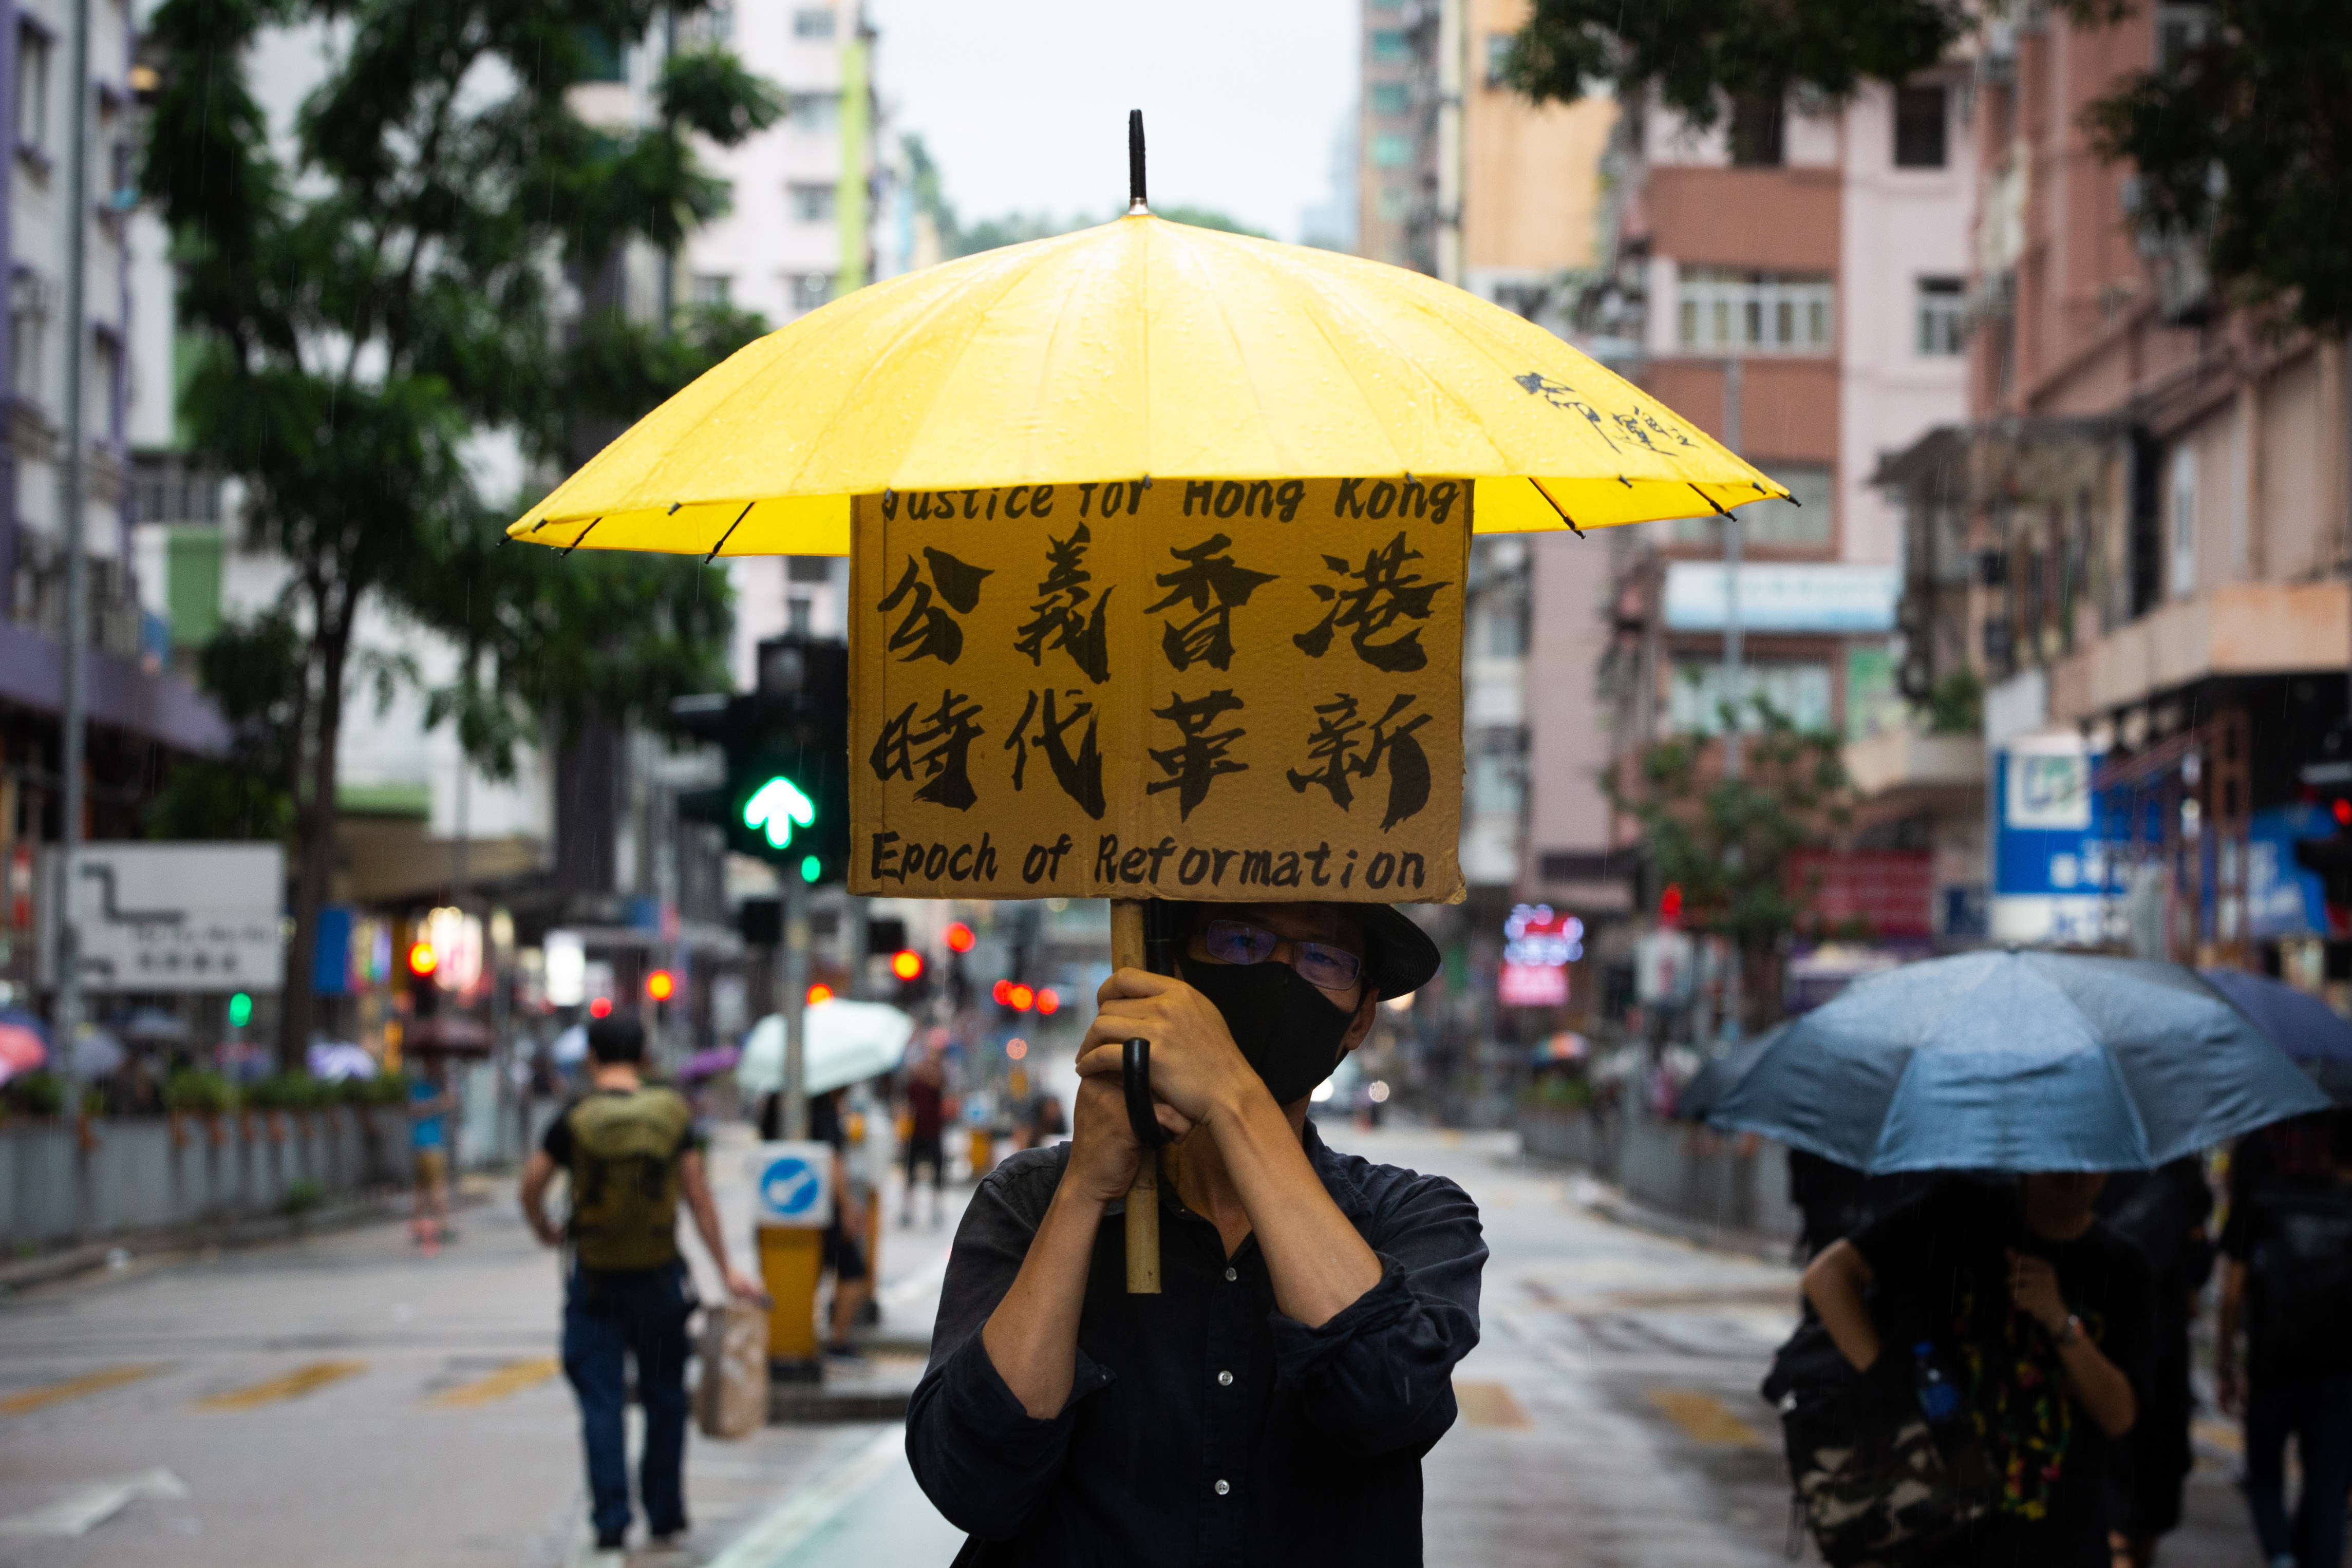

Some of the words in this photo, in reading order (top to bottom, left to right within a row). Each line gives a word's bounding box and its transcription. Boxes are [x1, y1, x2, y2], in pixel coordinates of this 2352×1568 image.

[1183, 479, 1306, 523] Hong
[1335, 477, 1460, 525] Kong
[877, 521, 1455, 684] 公義香港
[869, 688, 1433, 833] 時代革新
[871, 830, 998, 885] Epoch
[1022, 833, 1074, 884] of
[1094, 833, 1425, 890] Reformation
